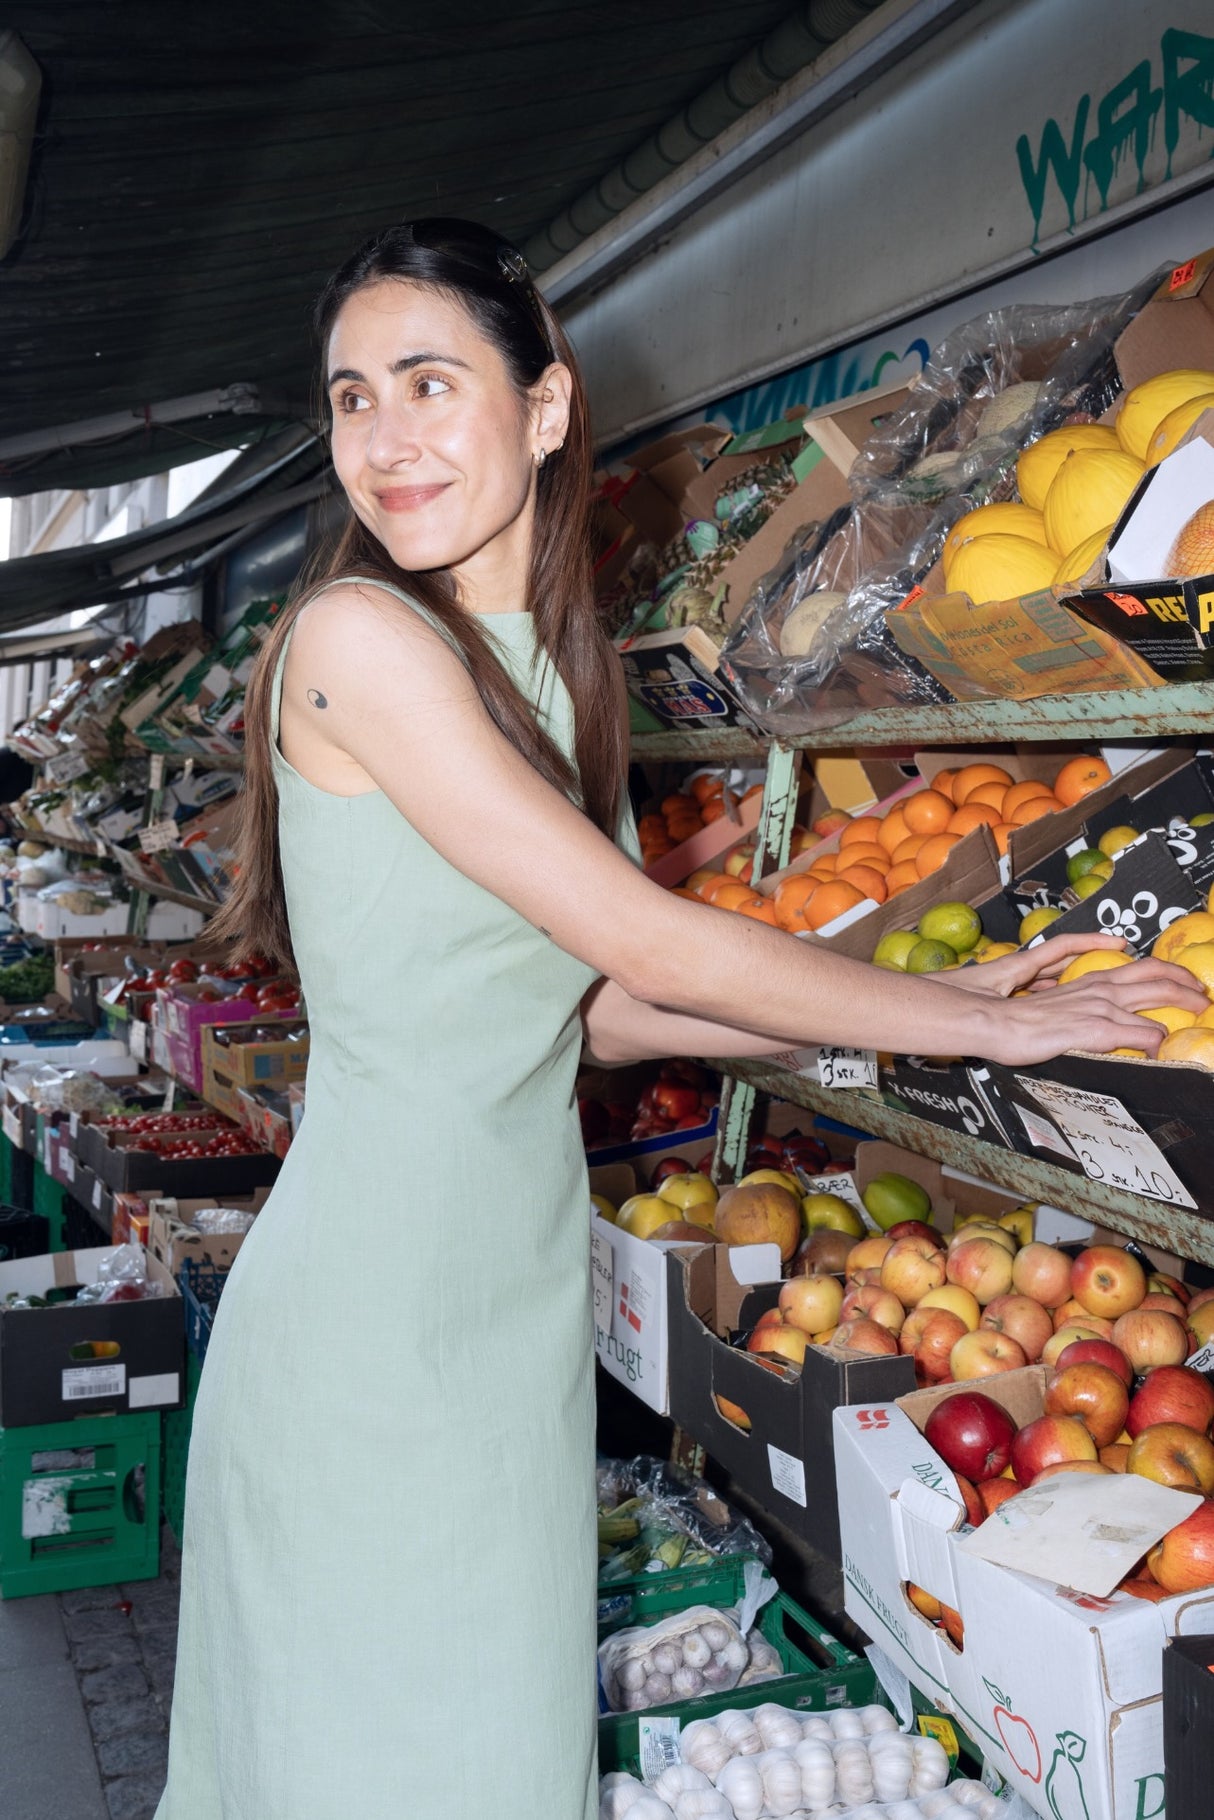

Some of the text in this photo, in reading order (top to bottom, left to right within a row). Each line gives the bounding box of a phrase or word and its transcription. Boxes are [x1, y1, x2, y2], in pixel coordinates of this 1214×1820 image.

[1145, 595, 1188, 622] RE
[1081, 1150, 1105, 1179] 3
[911, 1462, 956, 1502] DAN
[845, 1553, 876, 1605] DANSK
